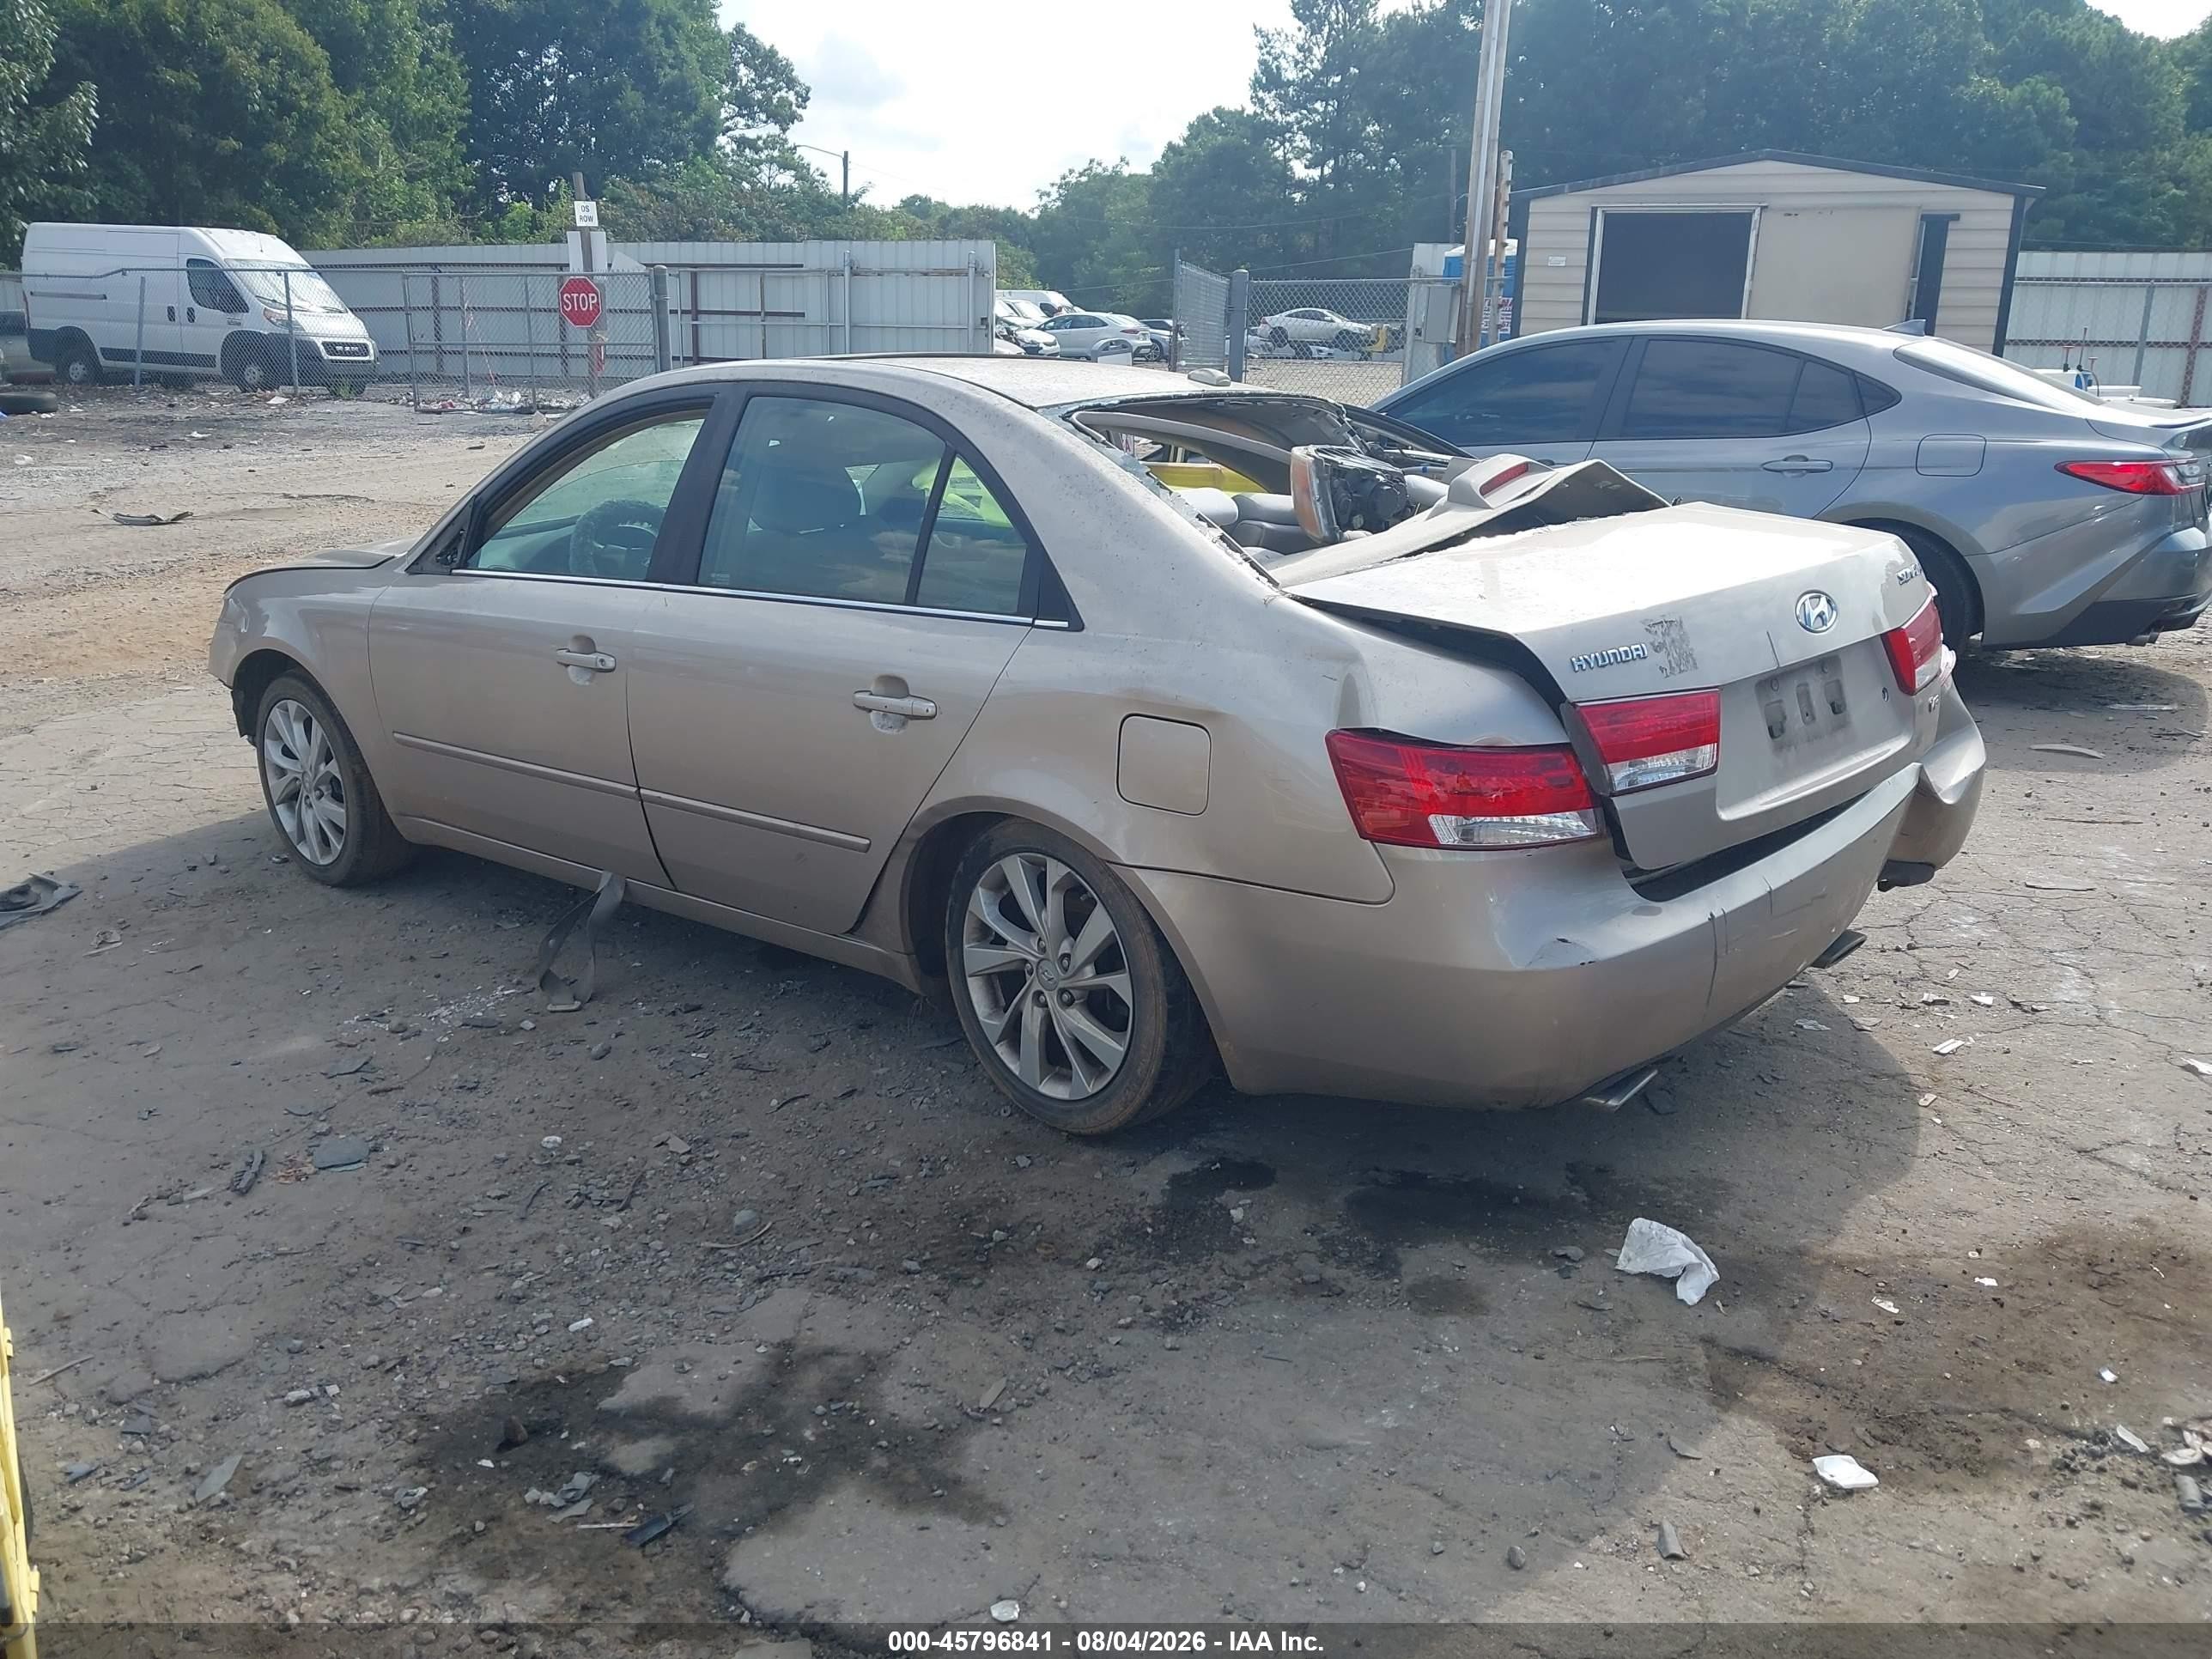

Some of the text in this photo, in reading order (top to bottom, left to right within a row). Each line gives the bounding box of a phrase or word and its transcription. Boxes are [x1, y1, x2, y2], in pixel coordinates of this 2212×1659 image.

[580, 214, 593, 223] ROW
[562, 293, 597, 312] STOP
[1571, 642, 1648, 672] HYUNDAI
